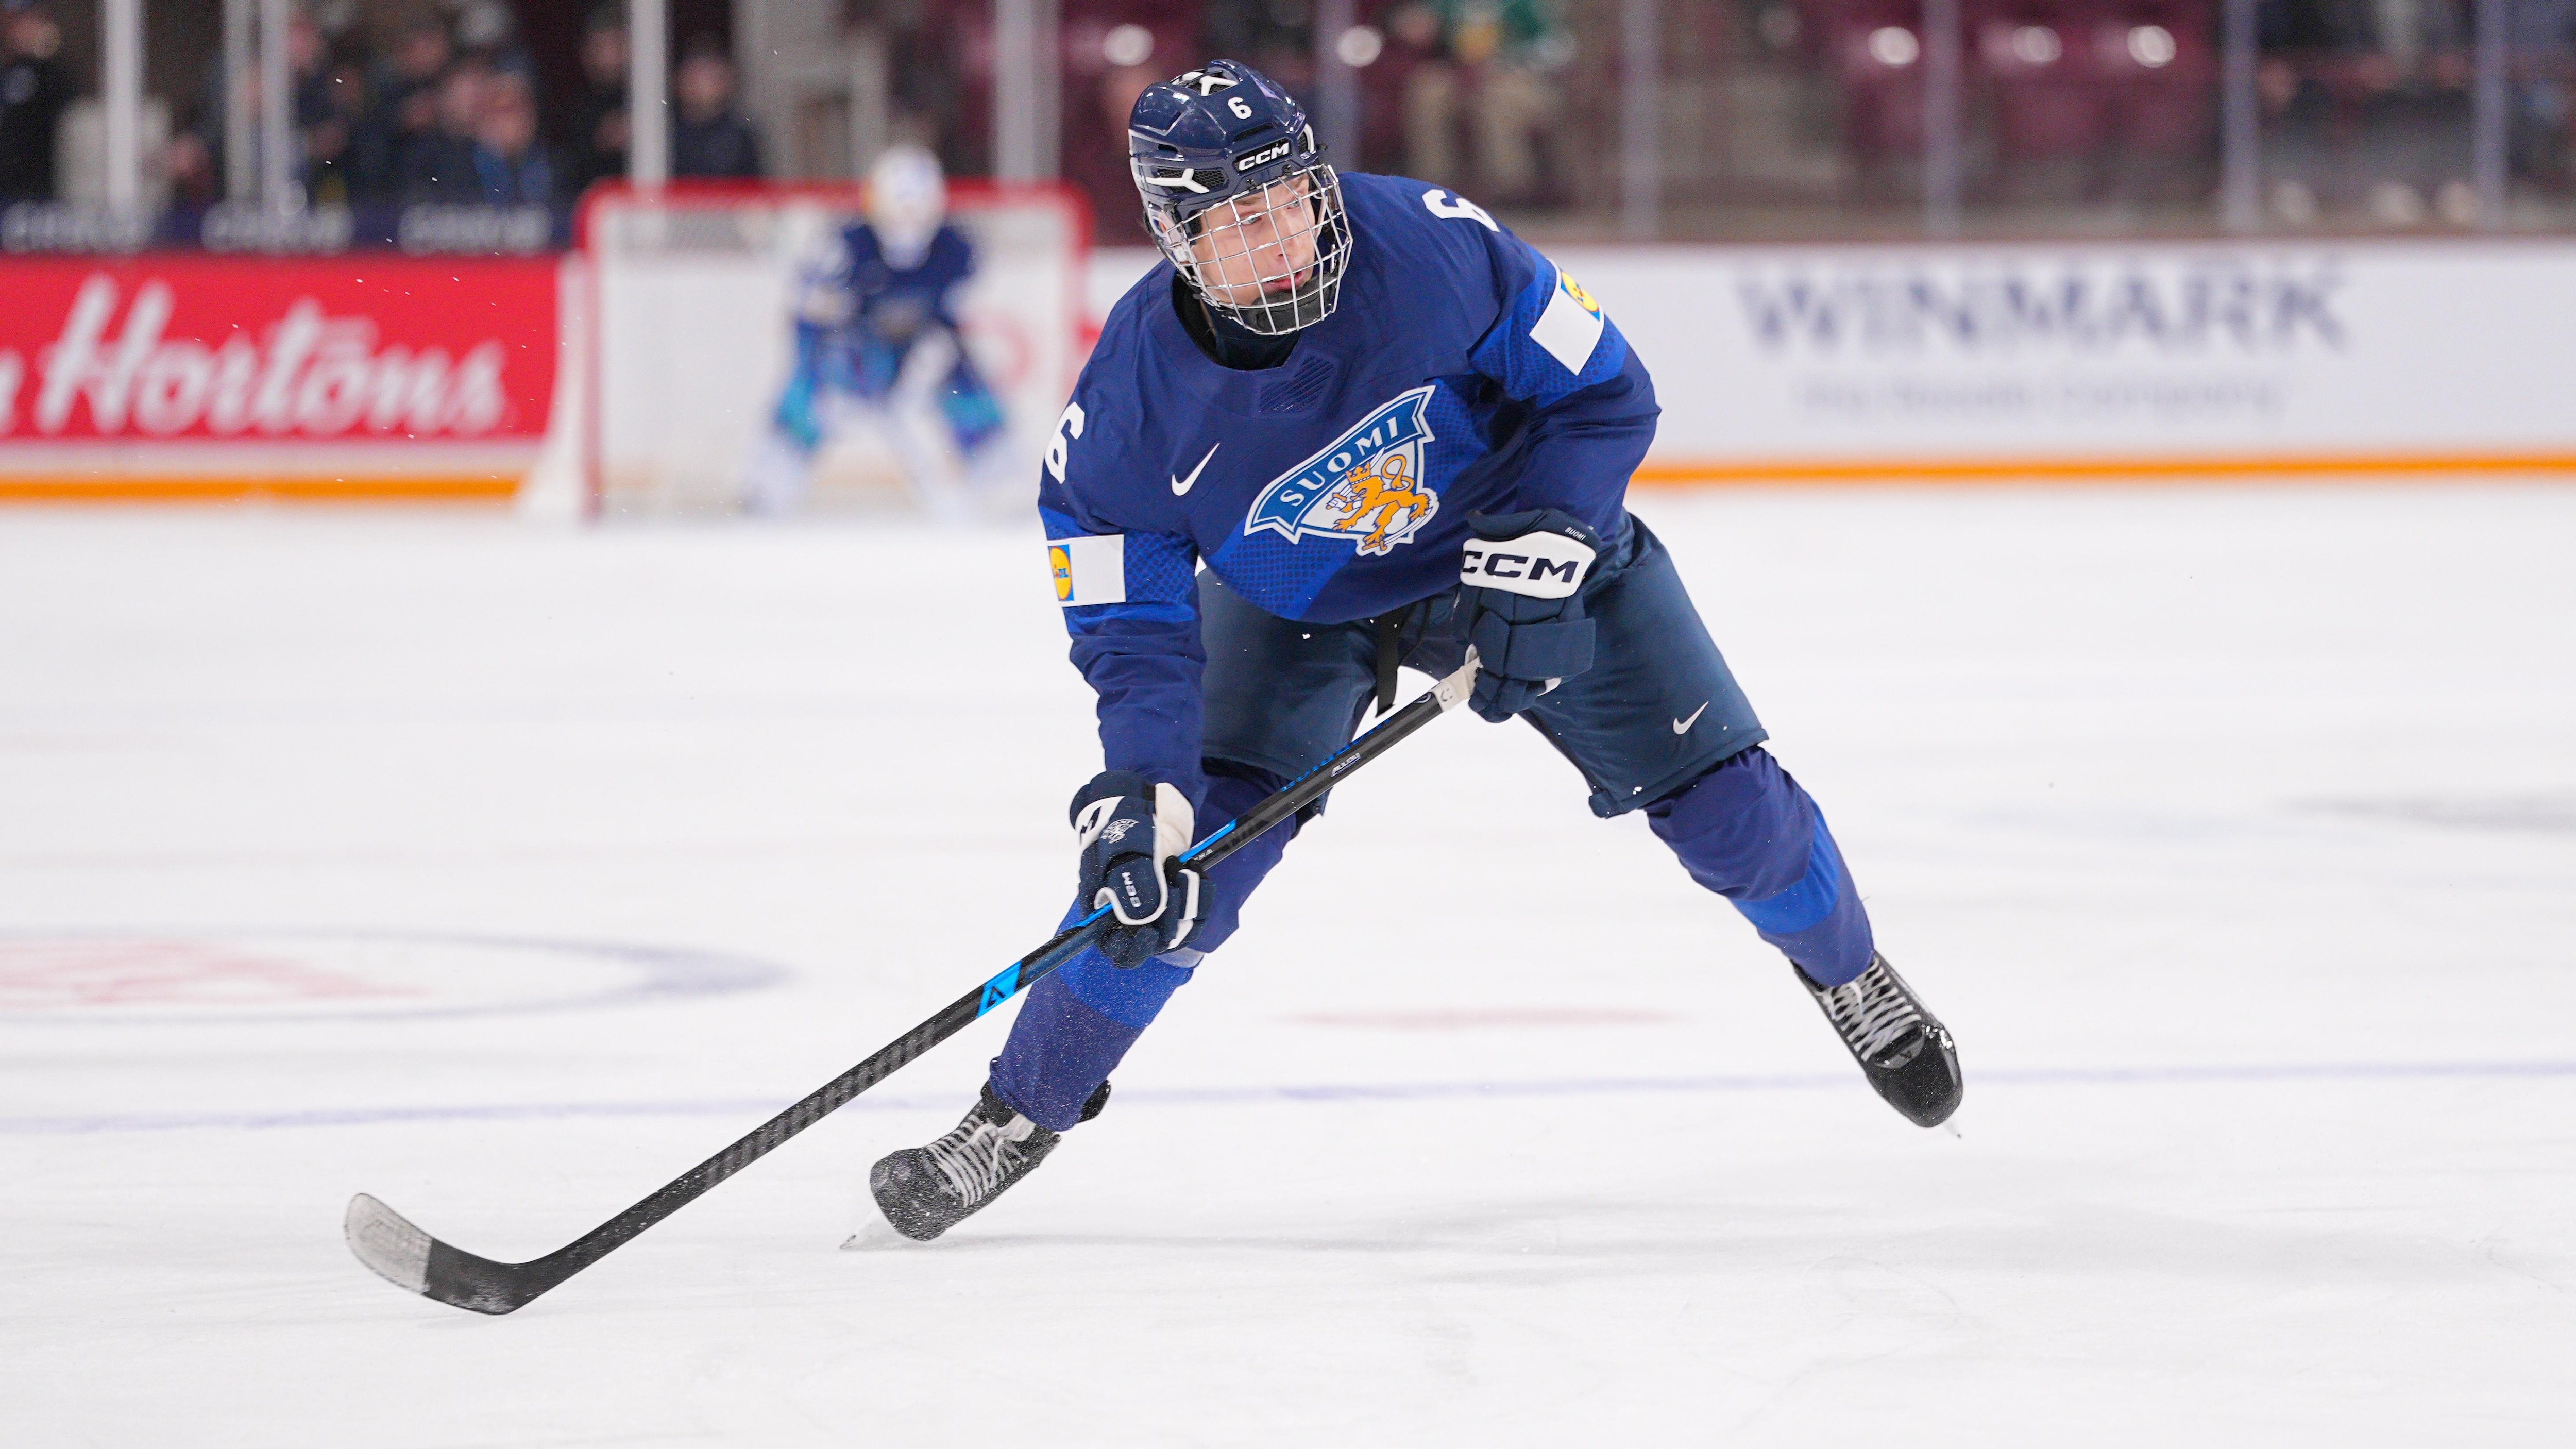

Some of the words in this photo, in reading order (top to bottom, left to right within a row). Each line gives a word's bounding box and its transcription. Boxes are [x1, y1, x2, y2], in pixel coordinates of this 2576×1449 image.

[1228, 96, 1252, 120] 6
[1238, 142, 1290, 171] CCM
[1736, 268, 2349, 350] WINMARK
[1045, 401, 1085, 484] 6
[1280, 416, 1398, 507] SUOMI
[1565, 527, 1587, 541] SUOMI
